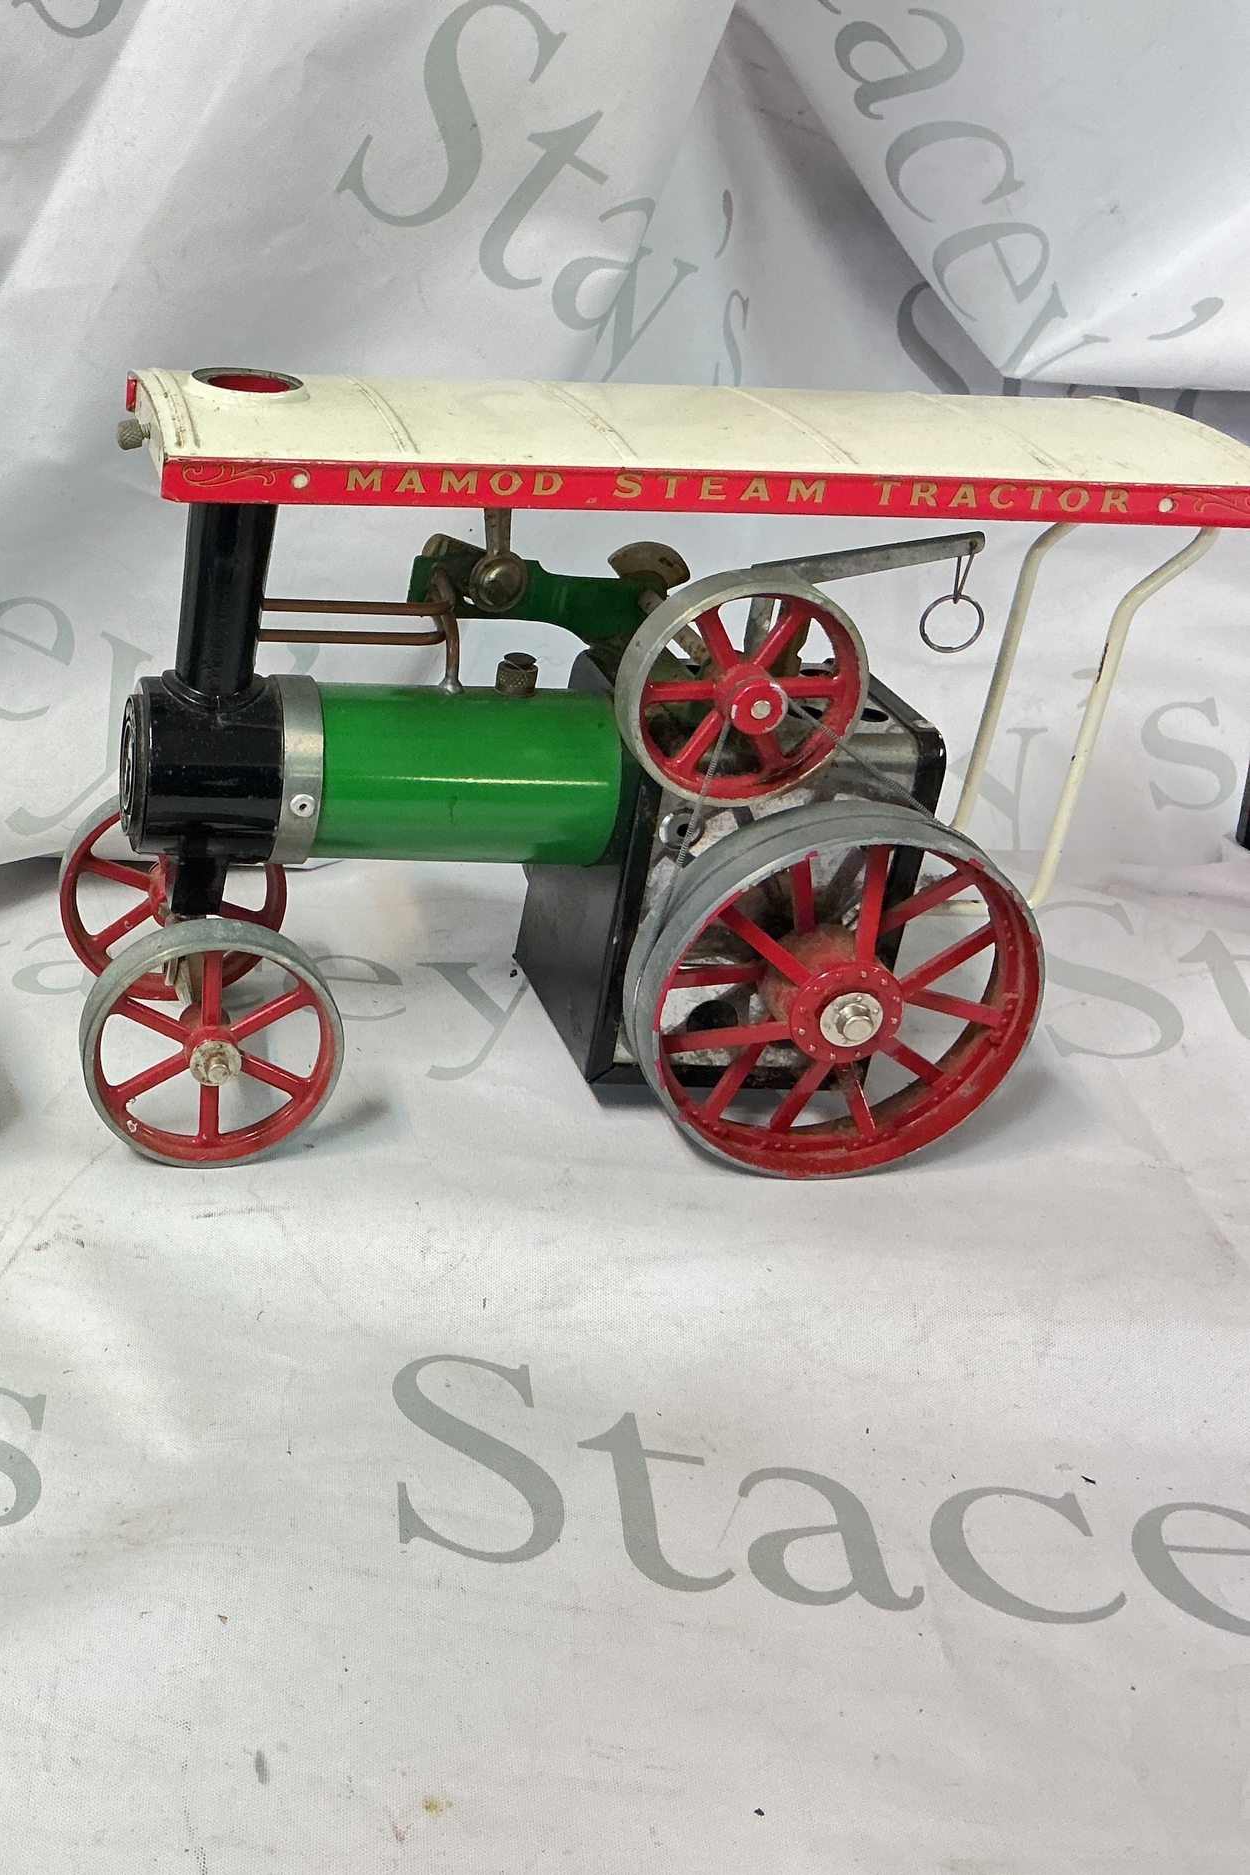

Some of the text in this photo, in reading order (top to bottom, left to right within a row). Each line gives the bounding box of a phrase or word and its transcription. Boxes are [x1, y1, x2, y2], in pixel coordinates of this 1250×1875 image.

[345, 466, 1130, 514] MAMOD STEAM TRACTOR
[392, 1353, 1250, 1638] Stace
